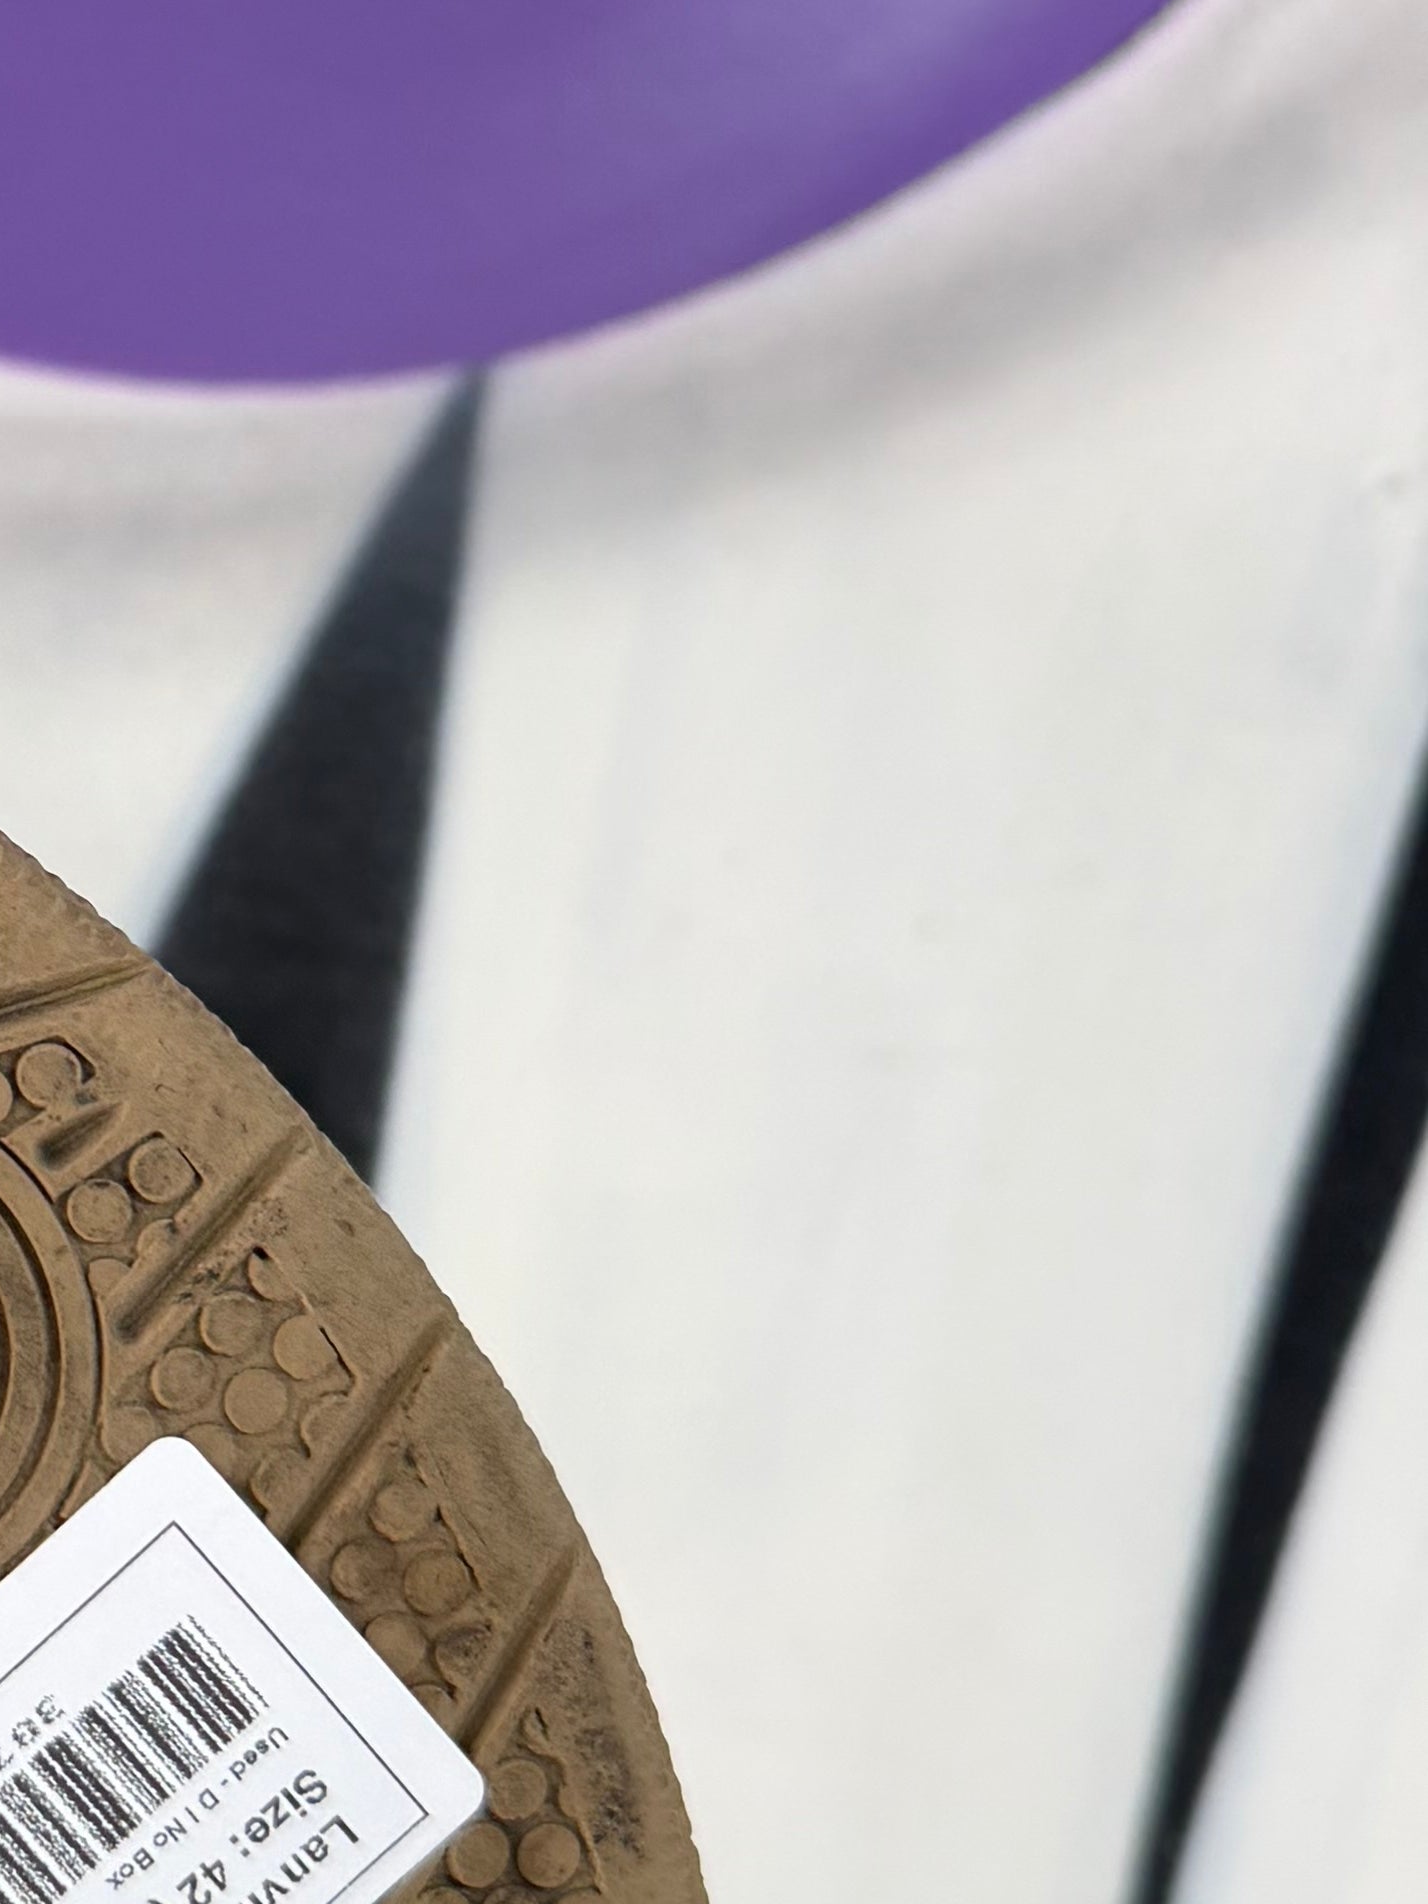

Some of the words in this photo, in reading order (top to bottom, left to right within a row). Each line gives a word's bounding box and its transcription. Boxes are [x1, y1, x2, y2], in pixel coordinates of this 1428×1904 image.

[228, 1726, 289, 1782] Used
[198, 1787, 220, 1810] D
[228, 1769, 328, 1858] Size:
[152, 1816, 187, 1847] No
[105, 1846, 155, 1890] Box
